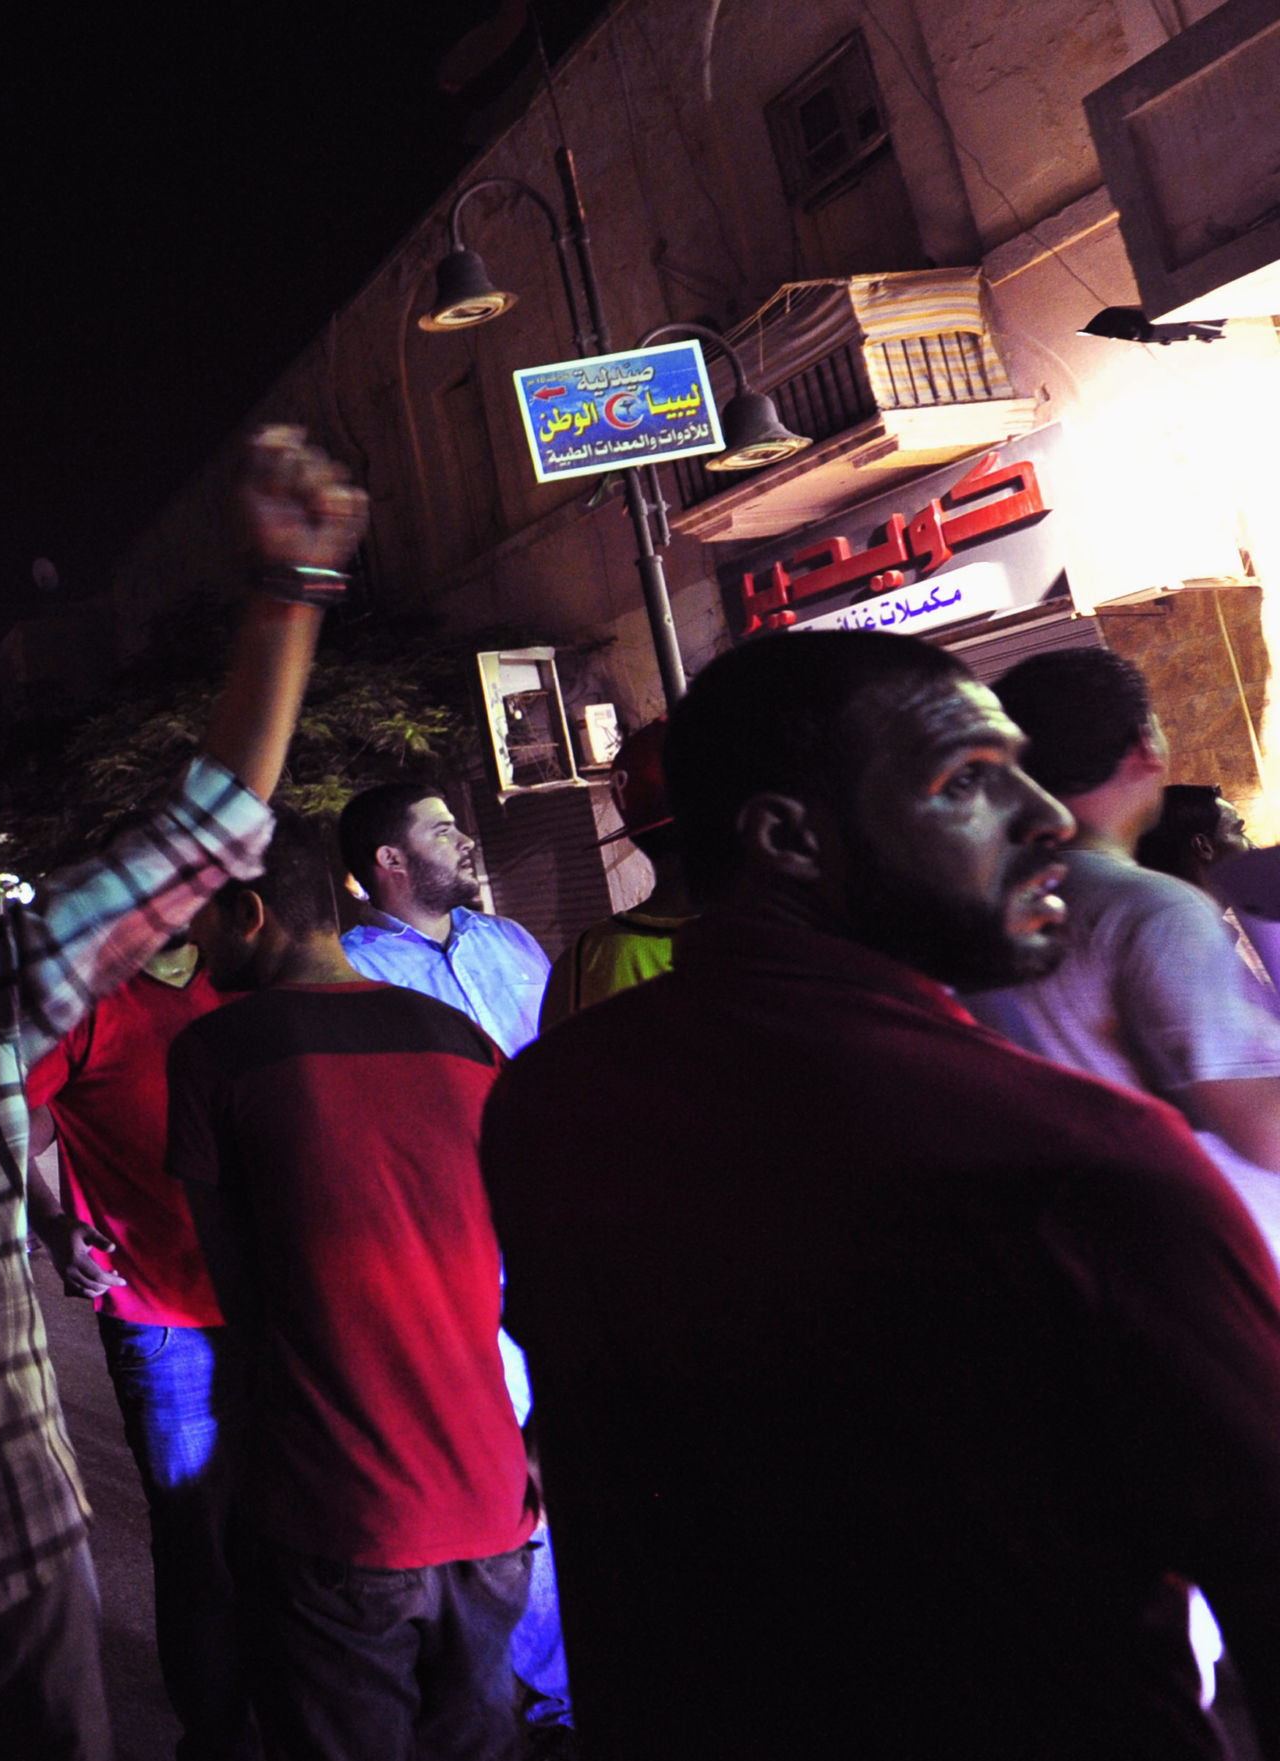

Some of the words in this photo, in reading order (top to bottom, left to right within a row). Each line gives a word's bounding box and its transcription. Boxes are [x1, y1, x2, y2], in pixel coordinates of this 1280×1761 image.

[645, 382, 702, 420] ليبيا
[539, 400, 600, 443] الوطن
[546, 444, 593, 467] الطبية
[595, 433, 657, 456] والمعدات
[879, 585, 963, 627] مكملات
